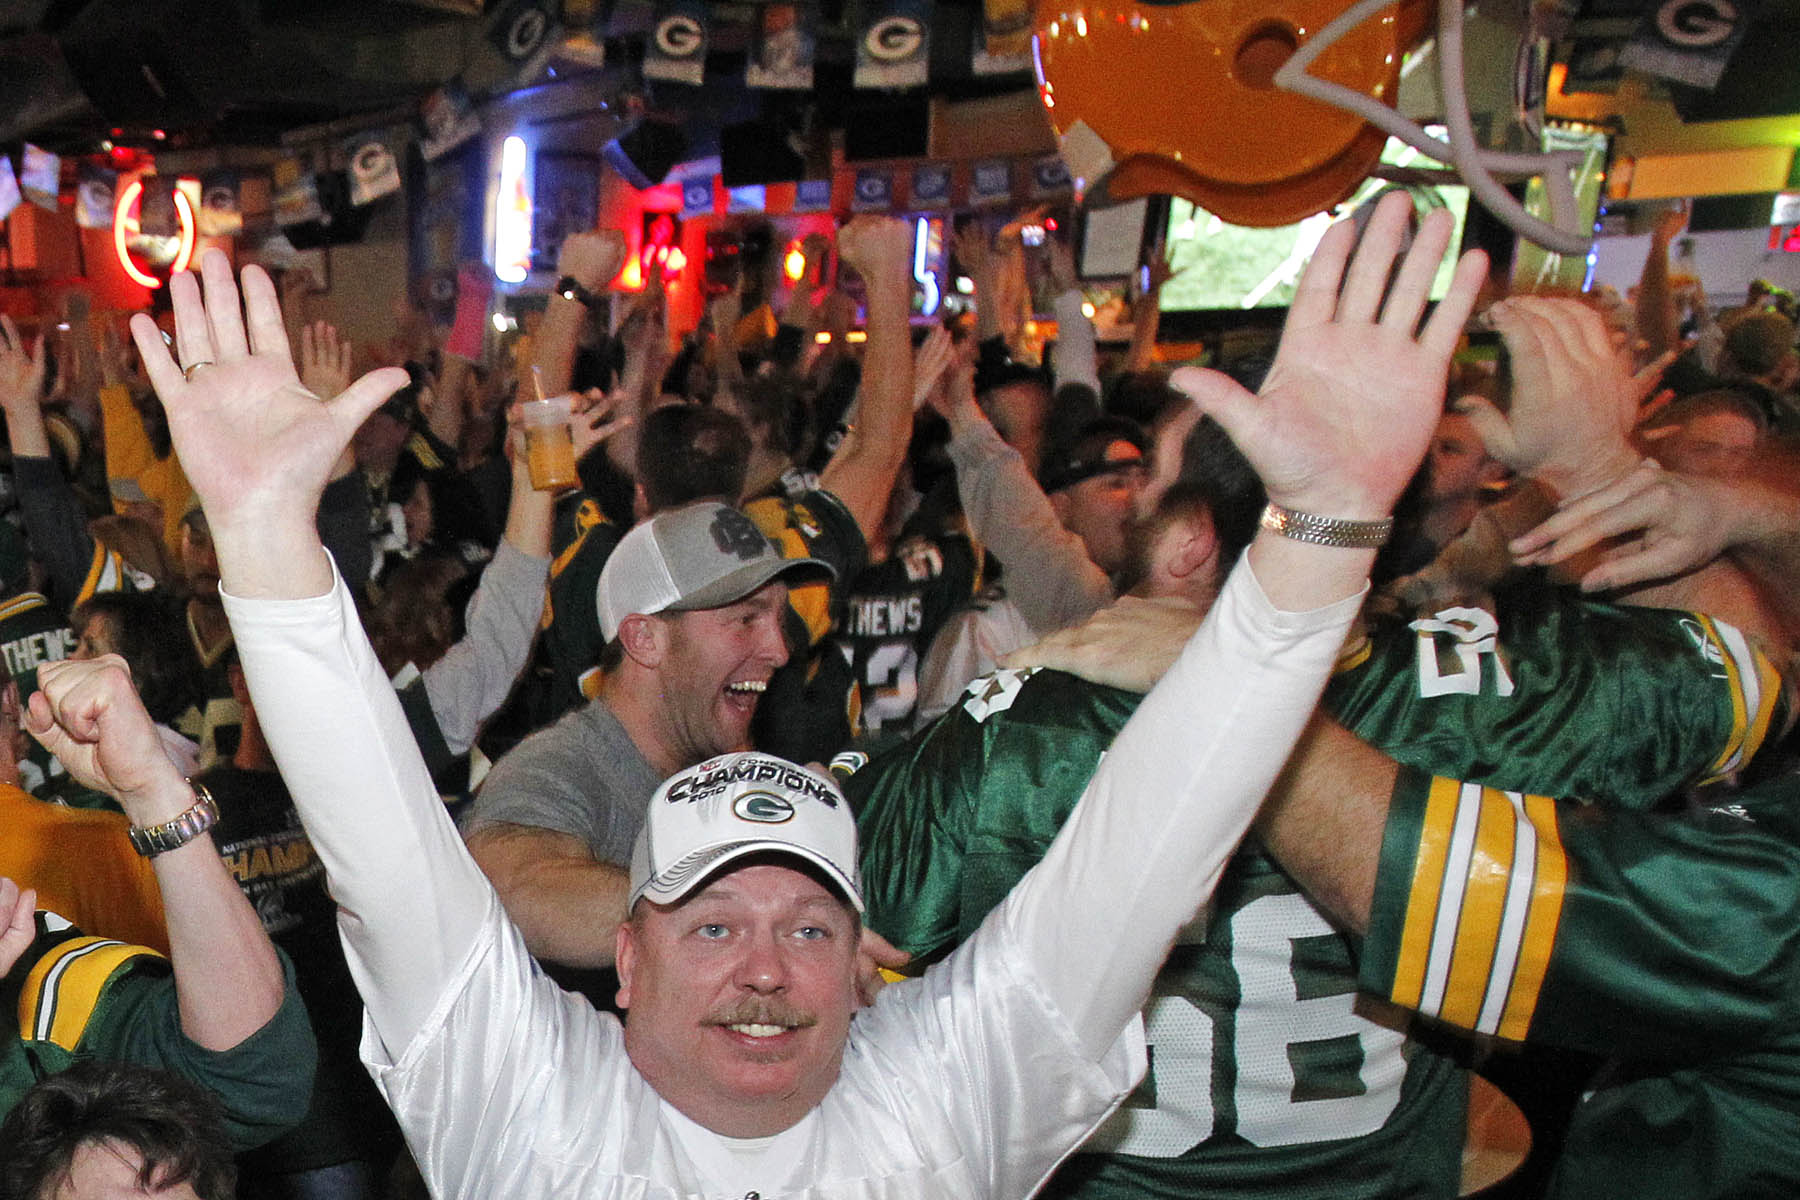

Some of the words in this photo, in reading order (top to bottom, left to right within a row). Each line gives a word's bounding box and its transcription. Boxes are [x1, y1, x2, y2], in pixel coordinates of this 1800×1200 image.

[865, 16, 921, 60] G
[840, 643, 918, 730] 2
[665, 764, 841, 810] CHAMPIONS
[687, 786, 727, 803] 2010
[732, 789, 795, 824] G
